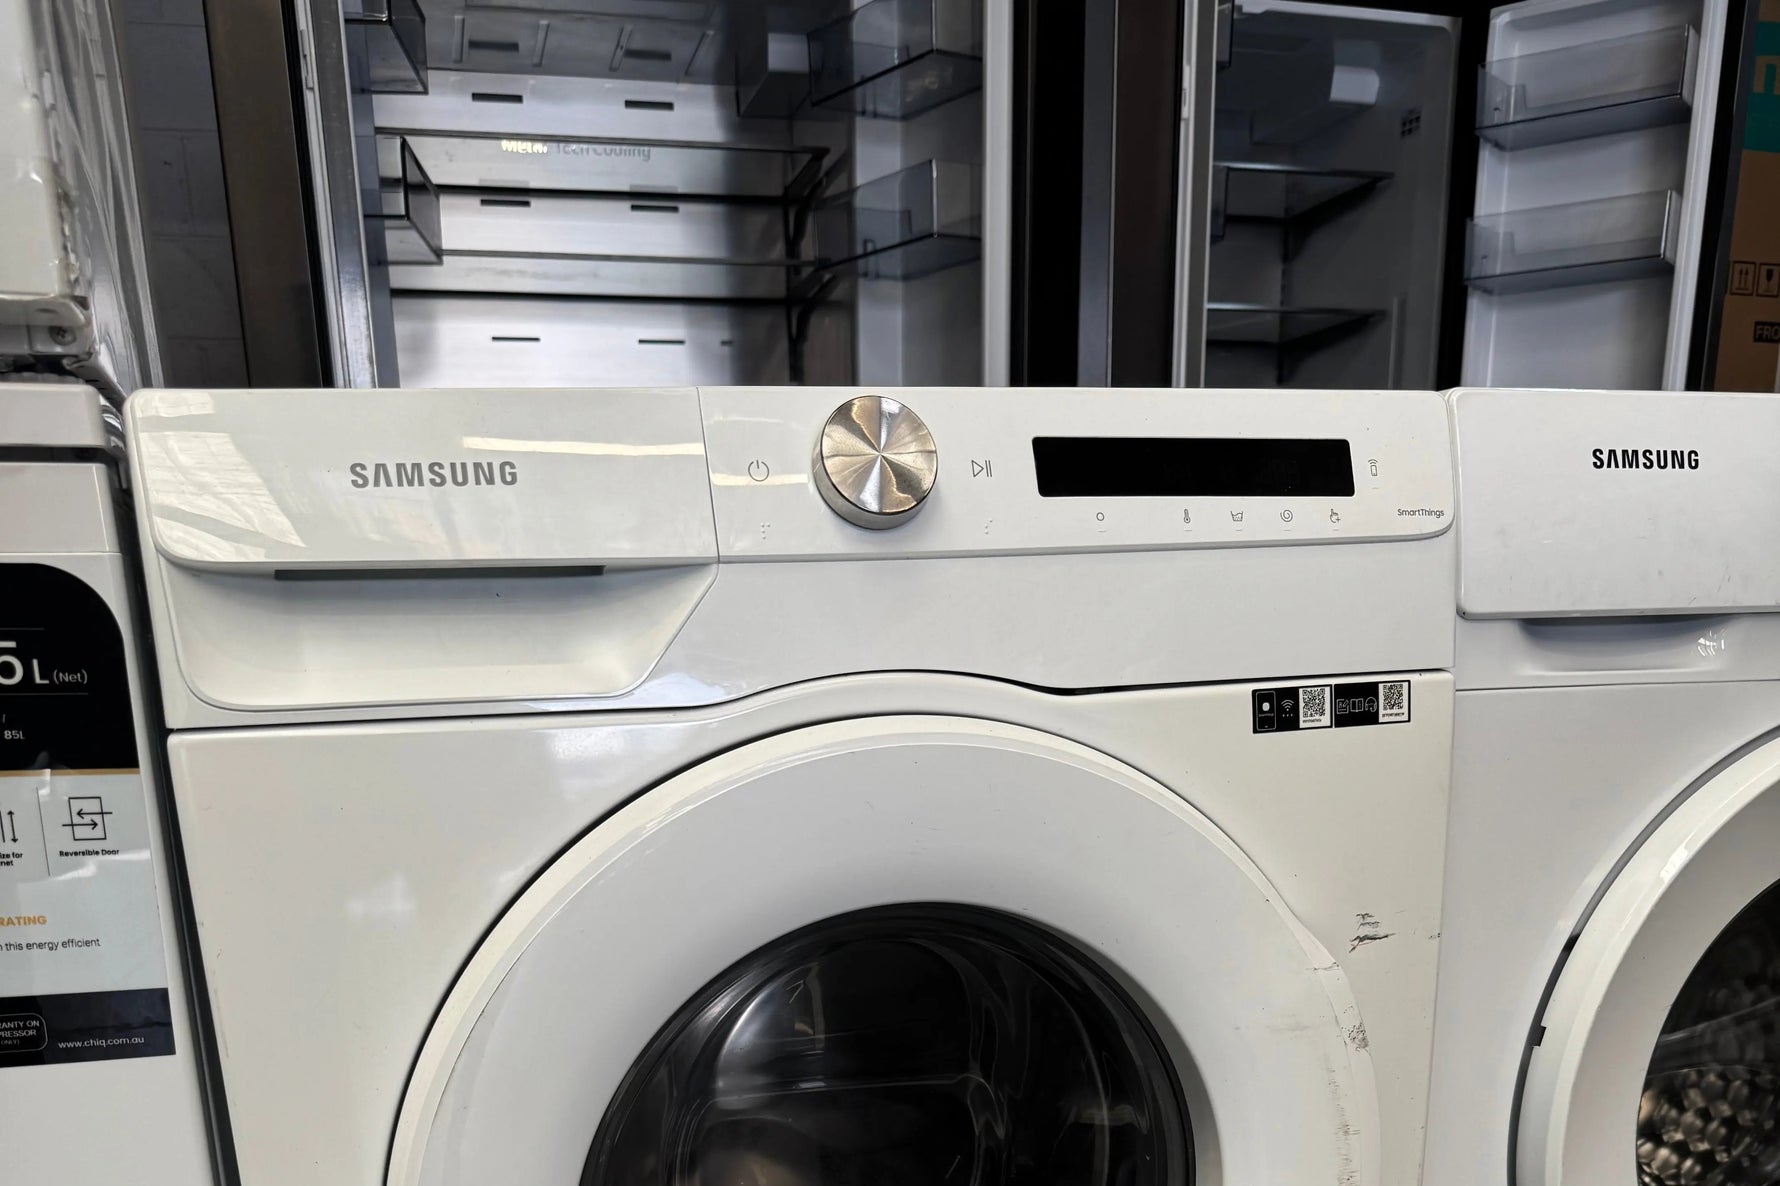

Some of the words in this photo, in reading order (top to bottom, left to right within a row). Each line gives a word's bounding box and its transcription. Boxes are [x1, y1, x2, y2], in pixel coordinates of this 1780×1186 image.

[1592, 448, 1699, 470] SAMSUNG
[349, 461, 518, 488] SAMSUNG
[1397, 508, 1445, 519] SmartThings
[53, 668, 88, 685] (Net)
[59, 850, 100, 858] Reversible
[101, 849, 120, 857] Door
[5, 942, 24, 951] this
[26, 941, 59, 951] energy
[61, 938, 101, 949] efficient
[58, 1036, 145, 1049] www.chiq.com.au
